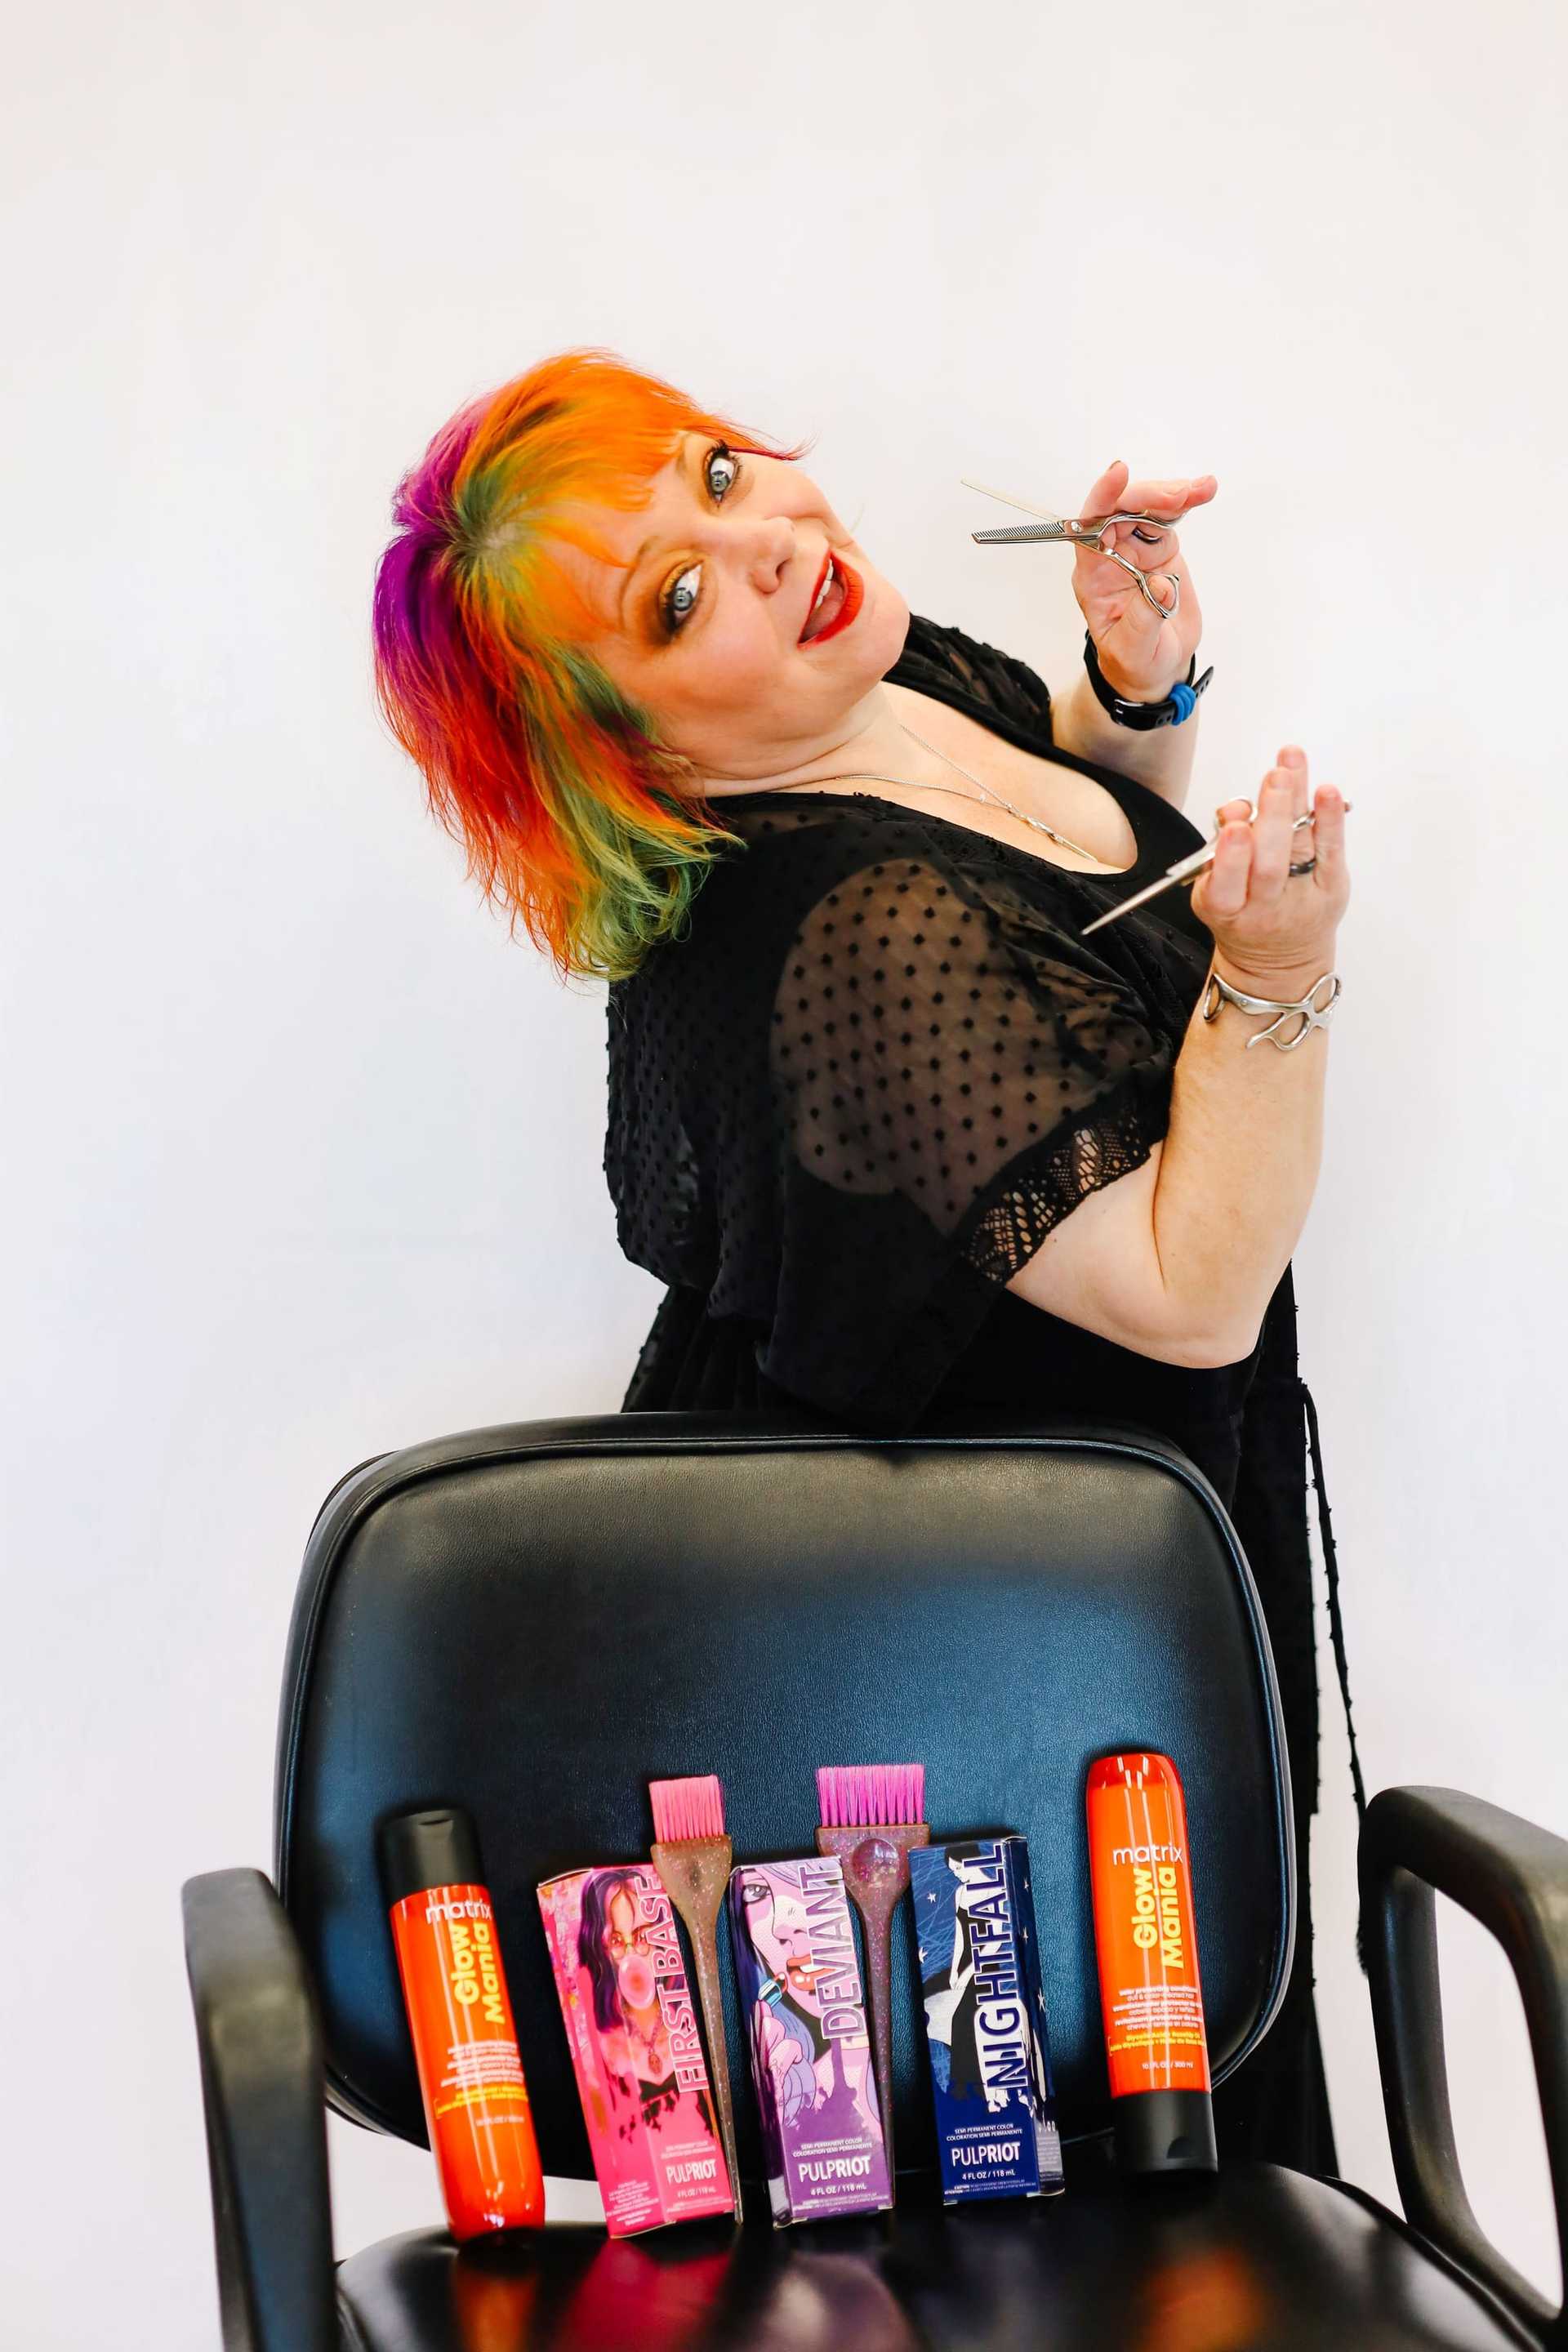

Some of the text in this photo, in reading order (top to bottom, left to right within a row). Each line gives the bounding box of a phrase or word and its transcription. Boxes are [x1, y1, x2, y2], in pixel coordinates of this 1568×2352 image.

[1112, 1842, 1183, 1865] matrix
[425, 1899, 492, 1924] matrix
[1131, 1868, 1158, 1949] Glow
[1154, 1867, 1184, 1970] Mania
[634, 1876, 685, 1976] BASE
[450, 1922, 480, 2005] Glow
[799, 1865, 868, 2040] DEVIANT
[470, 1922, 506, 2025] Mania
[961, 1842, 1029, 2091] NIGHTFALL
[657, 1984, 710, 2093] FIRST
[947, 2133, 978, 2141] COLORATION
[967, 2125, 996, 2133] PERMANENT
[951, 2140, 1021, 2167] PULPRIOT
[666, 2158, 717, 2184] PULPRIOT
[798, 2156, 871, 2183] PULPRIOT
[968, 2172, 976, 2180] FL
[977, 2172, 987, 2180] OZ
[817, 2187, 826, 2195] FL
[826, 2185, 836, 2194] OZ
